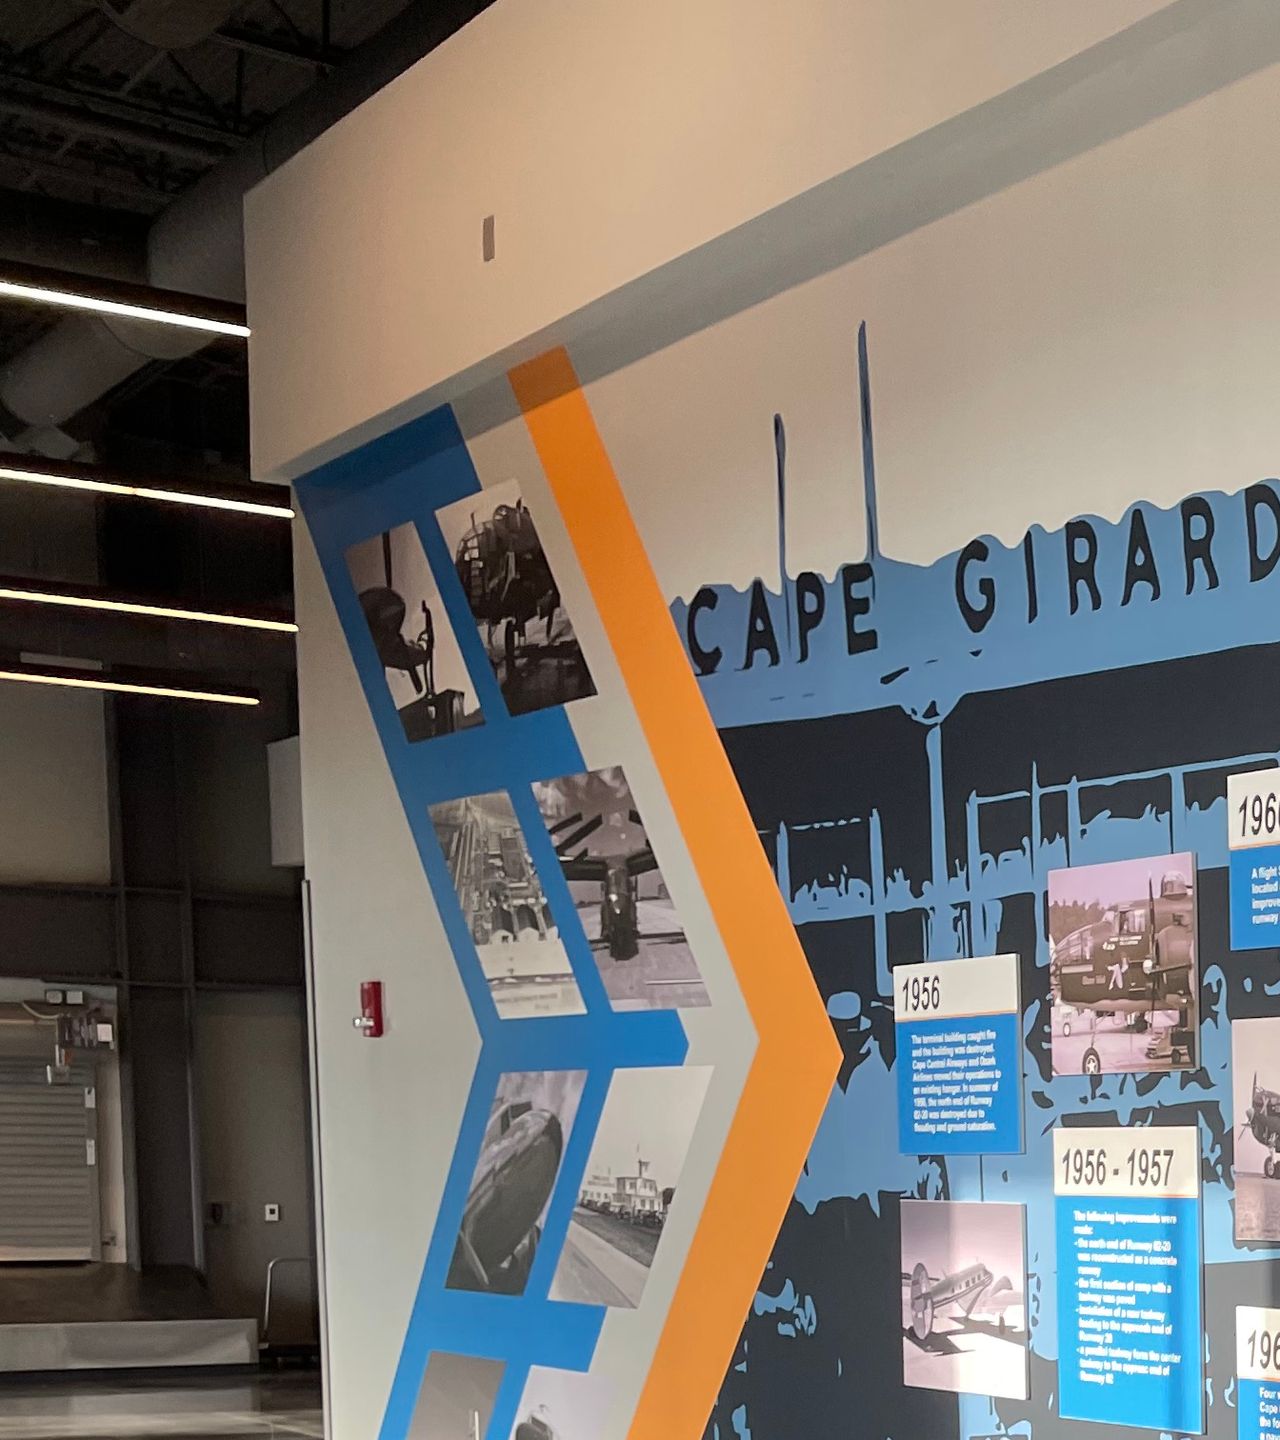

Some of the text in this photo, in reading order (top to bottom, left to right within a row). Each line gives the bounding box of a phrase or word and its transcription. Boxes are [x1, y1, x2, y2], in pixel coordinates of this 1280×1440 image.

[686, 562, 878, 678] CAPE
[902, 975, 940, 1012] 1956
[1062, 1148, 1107, 1186] 1956
[1127, 1149, 1174, 1187] 1957
